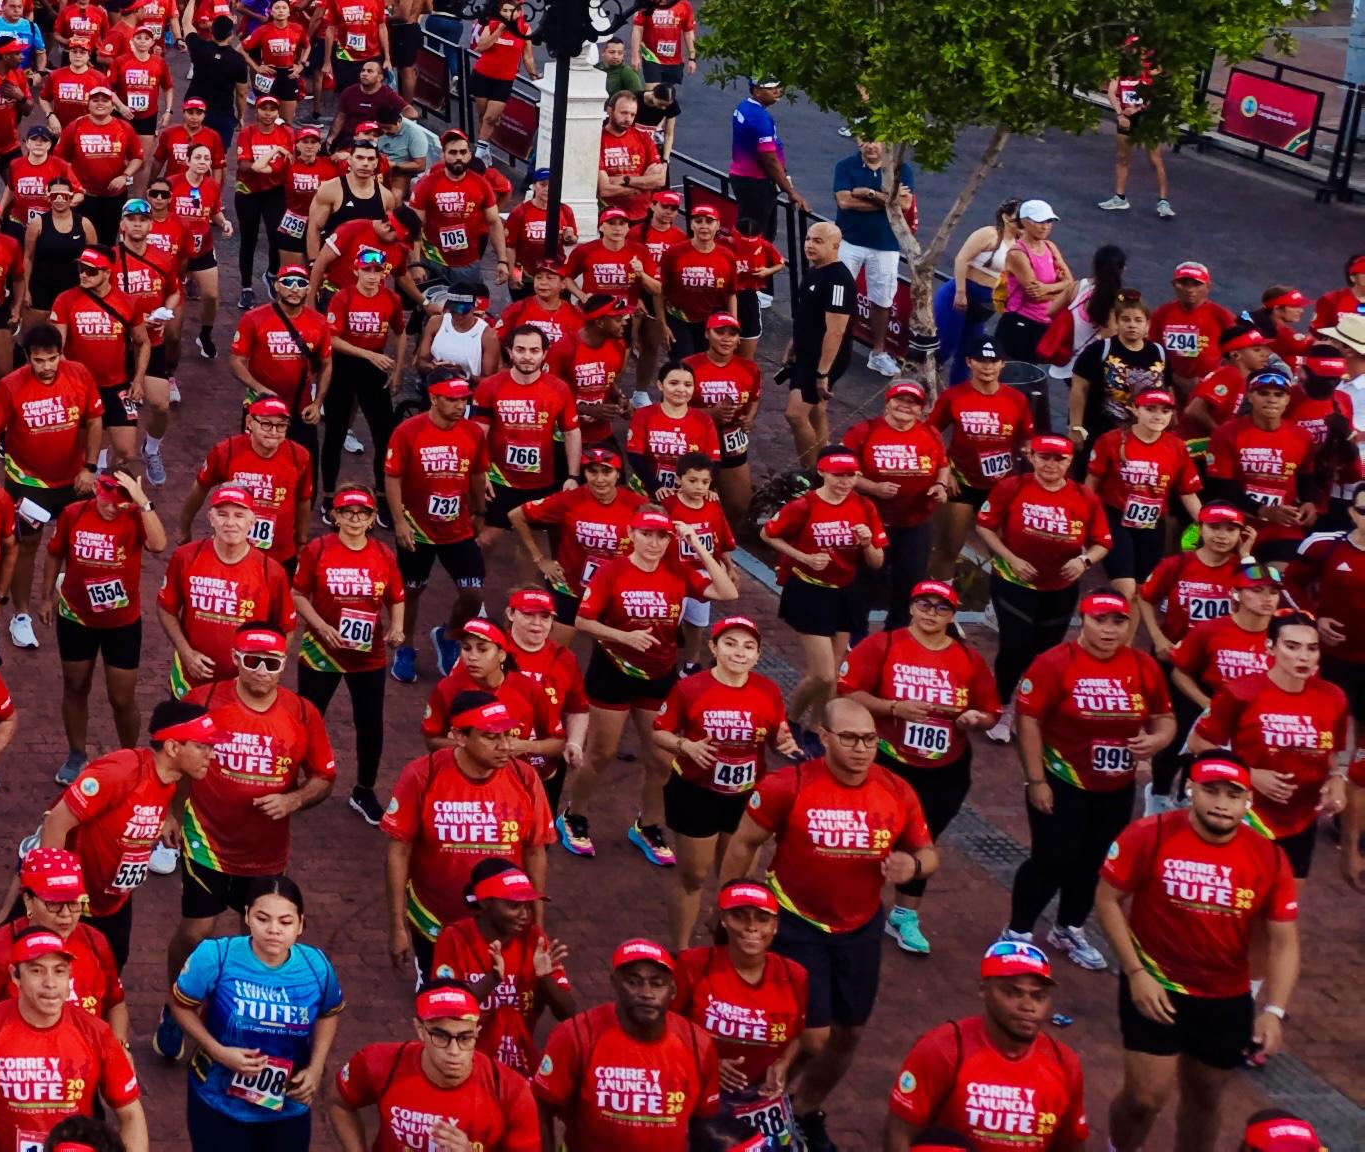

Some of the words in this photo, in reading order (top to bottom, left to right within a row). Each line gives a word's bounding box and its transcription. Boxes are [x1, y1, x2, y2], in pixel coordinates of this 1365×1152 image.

[131, 97, 146, 107] 113
[442, 229, 466, 245] 705
[1166, 334, 1196, 350] 294
[725, 428, 748, 450] 510
[509, 448, 539, 466] 766
[983, 455, 1013, 475] 1023
[431, 497, 459, 515] 732
[1127, 503, 1159, 523] 039
[89, 586, 125, 604] 1554
[1191, 599, 1230, 621] 204
[341, 619, 373, 643] 260
[909, 725, 946, 750] 1186
[1095, 748, 1133, 770] 999
[718, 763, 753, 785] 481
[434, 801, 481, 812] CORRE
[485, 801, 495, 813] Y
[434, 812, 497, 824] ANUNCIA
[501, 821, 518, 831] 20
[434, 824, 466, 841] TU
[470, 825, 499, 842] FE
[502, 831, 519, 842] 26
[115, 863, 148, 886] 555
[1163, 858, 1217, 876] CORRE
[1221, 866, 1232, 877] Y
[1163, 869, 1232, 888] ANUNCIA
[1162, 880, 1197, 900] TU
[1201, 886, 1232, 906] FE
[1236, 888, 1255, 899] 20
[1235, 898, 1252, 909] 26
[233, 997, 266, 1020] TU
[271, 1004, 297, 1024] FE
[595, 1066, 646, 1080] CORRE
[650, 1070, 660, 1082] Y
[597, 1079, 662, 1094] ANUNCIA
[596, 1091, 629, 1111] TU
[633, 1094, 663, 1114] FE
[667, 1091, 685, 1103] 20
[667, 1104, 683, 1114] 26
